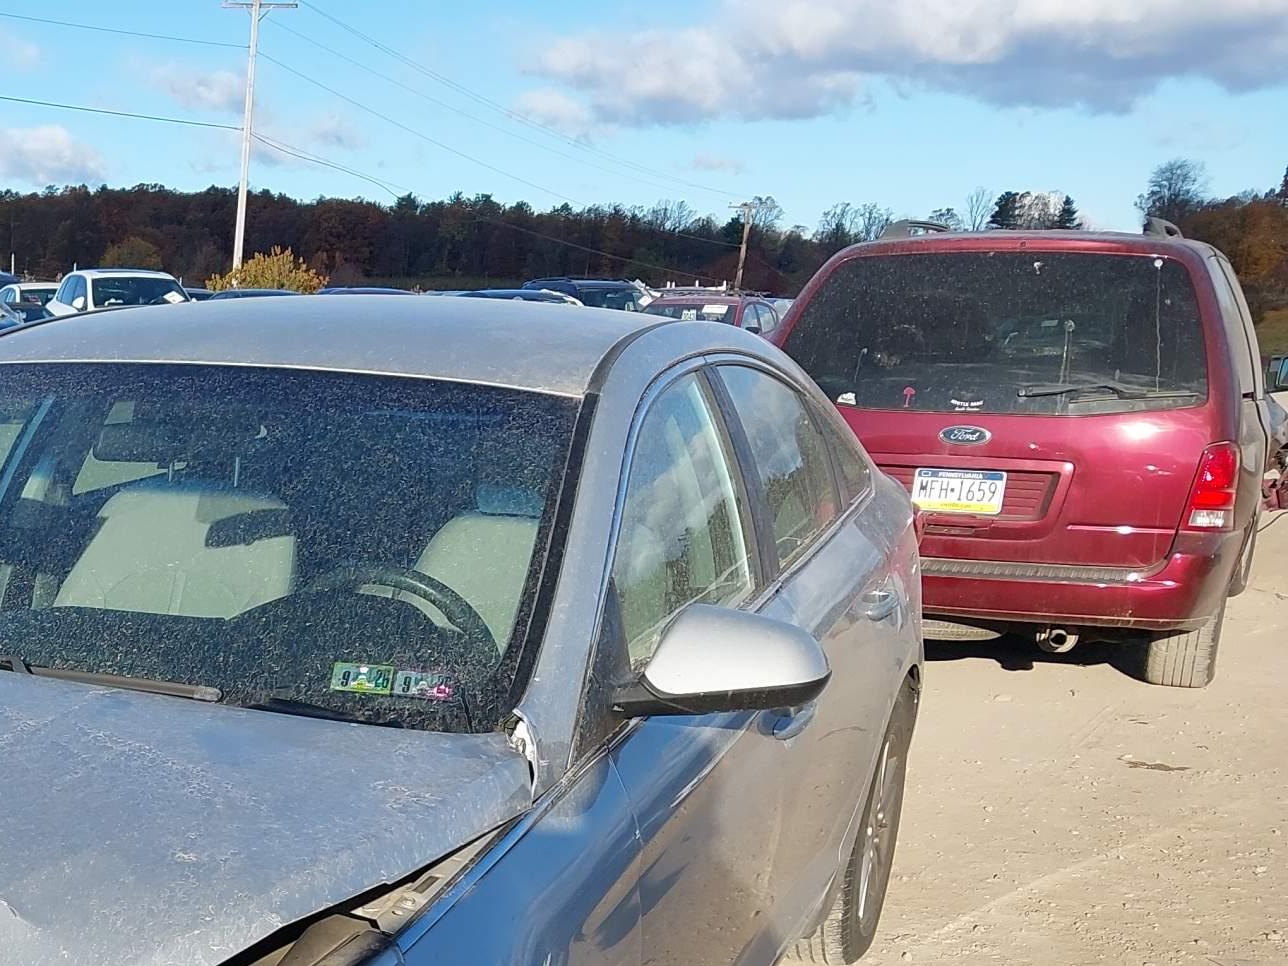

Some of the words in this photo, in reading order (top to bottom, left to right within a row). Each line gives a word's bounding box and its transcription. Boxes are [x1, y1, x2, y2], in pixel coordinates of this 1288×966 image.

[950, 428, 980, 441] Ford
[340, 670, 351, 687] 9
[401, 675, 412, 693] 9
